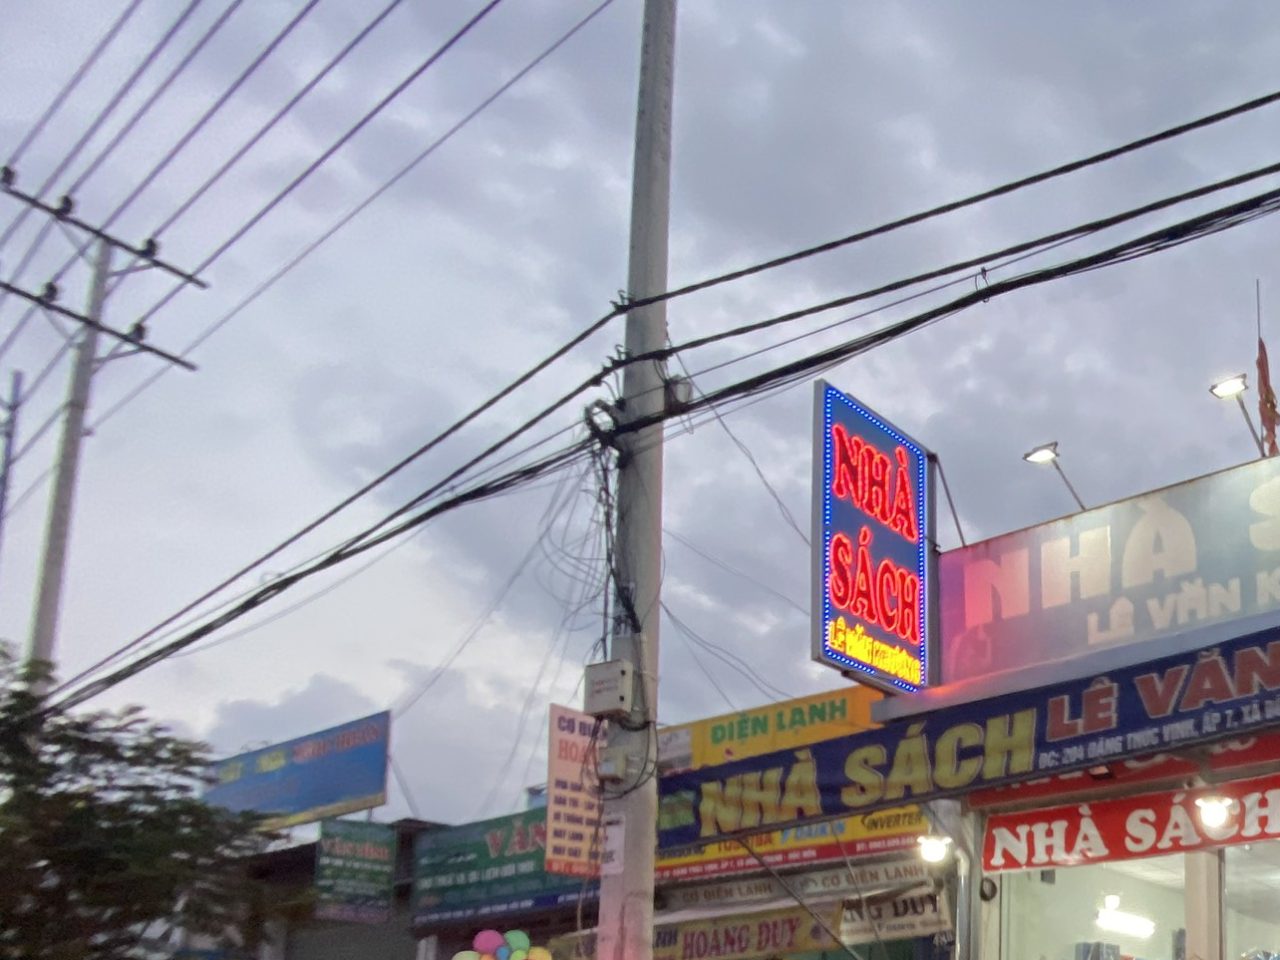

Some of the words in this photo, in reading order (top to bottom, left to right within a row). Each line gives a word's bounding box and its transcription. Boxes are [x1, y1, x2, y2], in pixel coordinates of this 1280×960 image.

[833, 424, 917, 543] NHÀ
[829, 526, 920, 645] SÁCH
[964, 497, 1198, 628] NHÀ
[1087, 596, 1134, 646] LÊ
[1146, 576, 1242, 630] VĂN
[710, 710, 770, 746] ĐIỆN
[775, 697, 848, 735] LẠNH
[1046, 676, 1119, 742] LÊ
[699, 749, 822, 838] NHÀ
[841, 706, 1039, 808] SÁCH
[990, 803, 1110, 867] NHÀ
[757, 917, 800, 949] DUY
